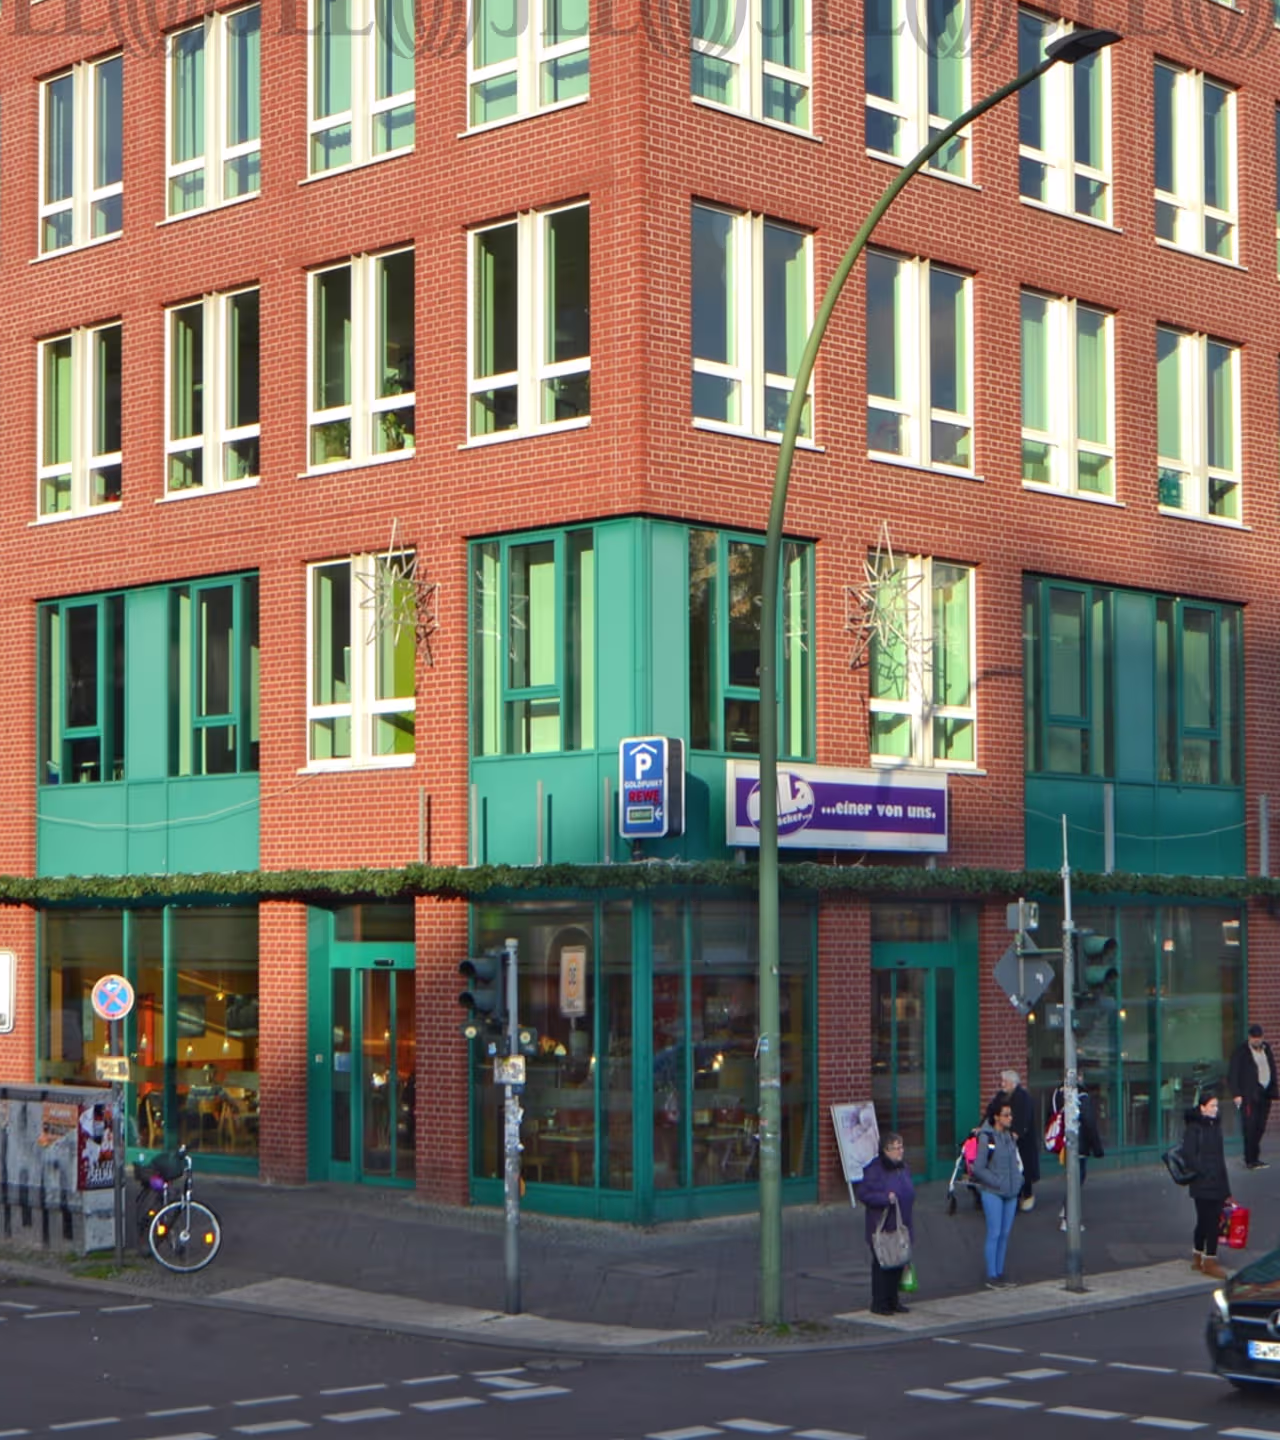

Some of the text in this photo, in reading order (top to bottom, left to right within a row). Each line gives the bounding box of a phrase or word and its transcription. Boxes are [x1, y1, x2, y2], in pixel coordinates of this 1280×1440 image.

[636, 753, 651, 780] P
[821, 800, 936, 819] ...einer von uns.
